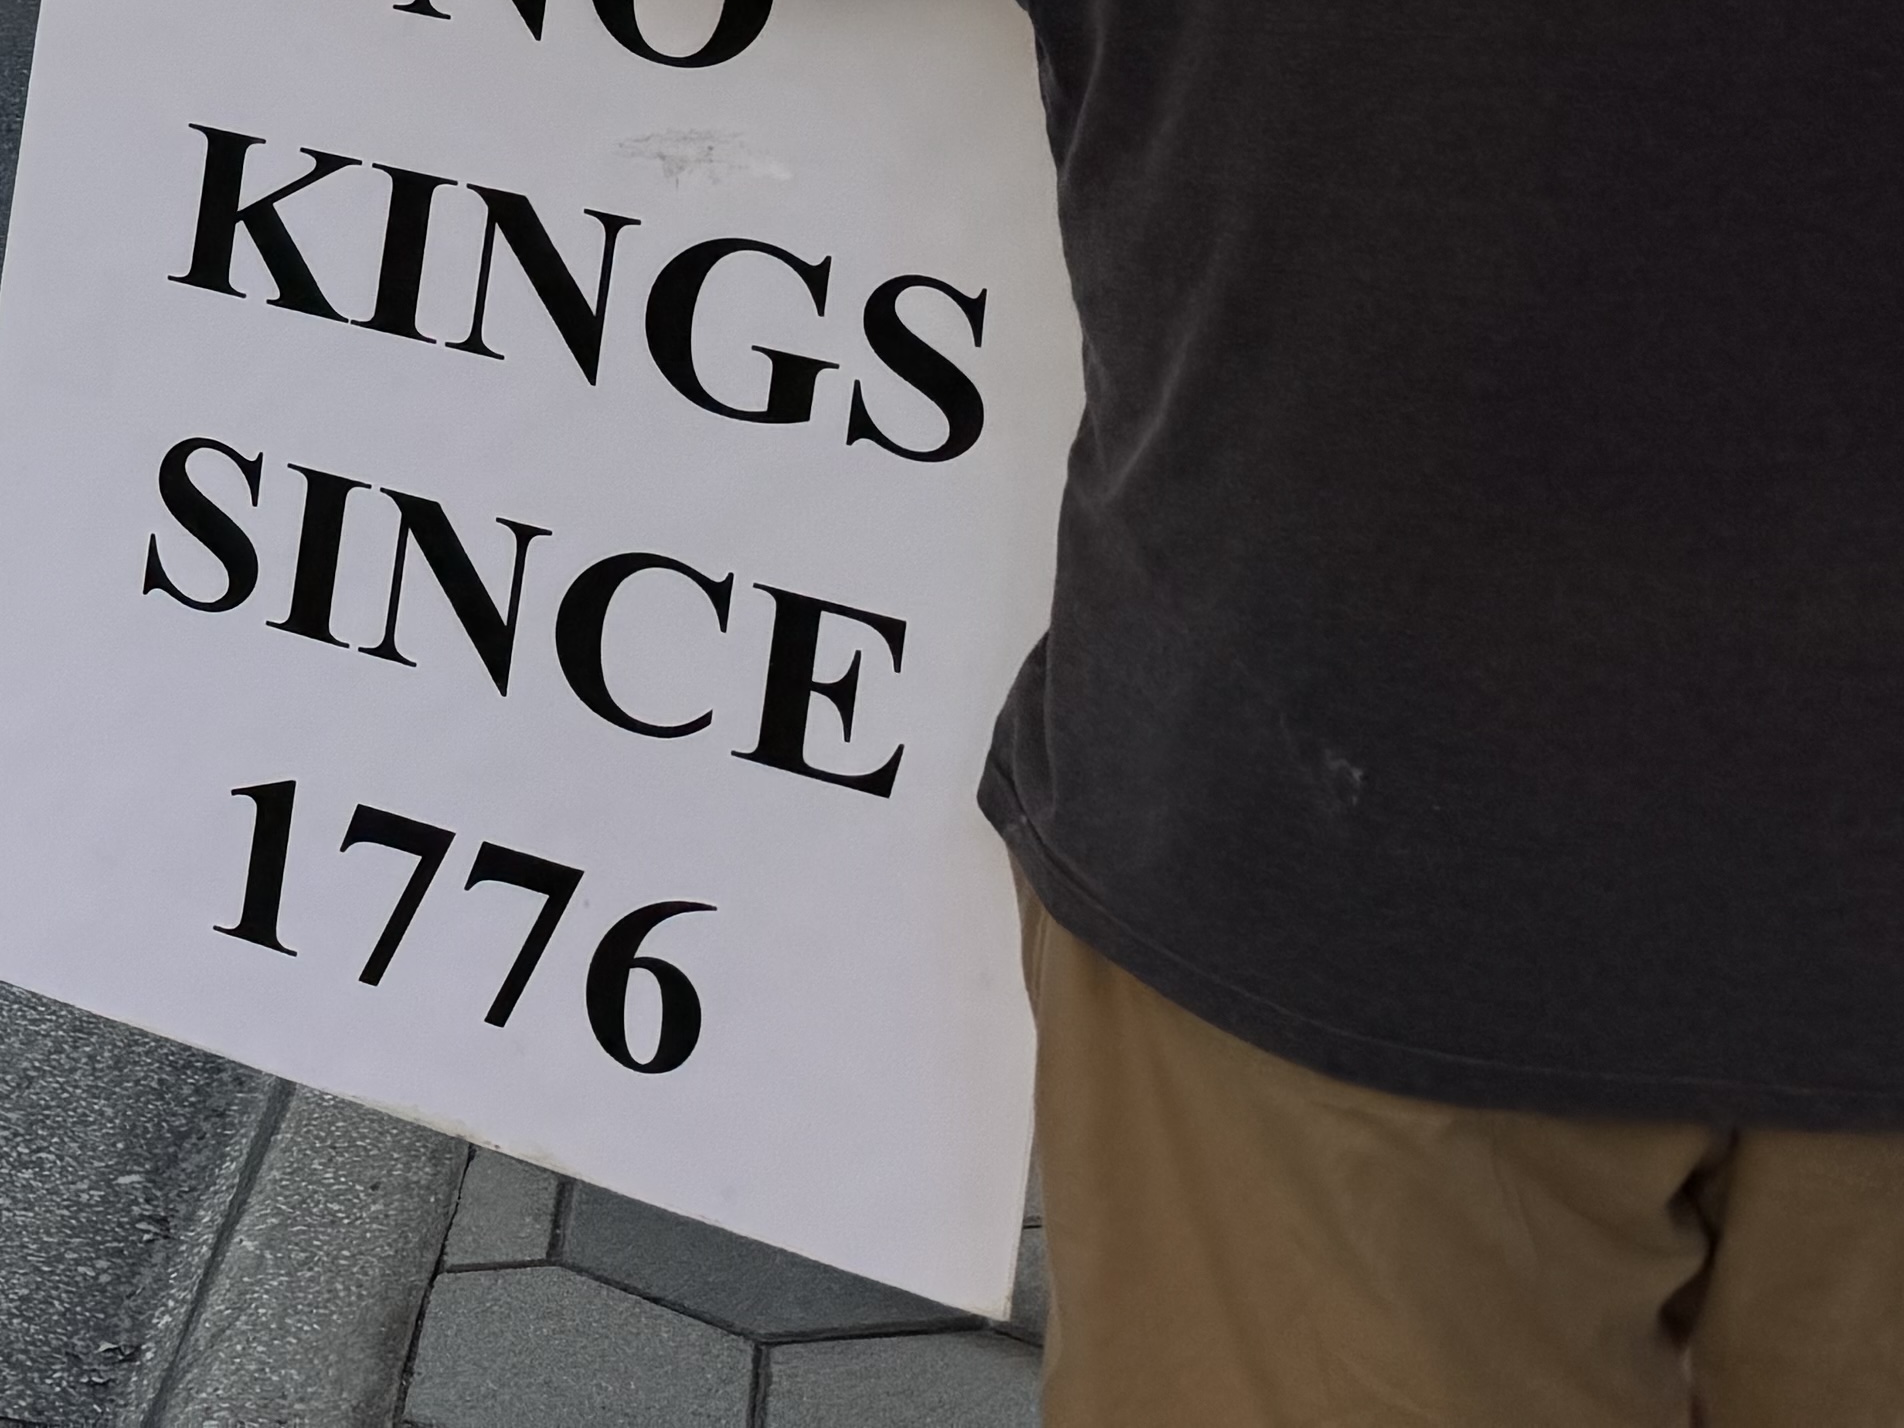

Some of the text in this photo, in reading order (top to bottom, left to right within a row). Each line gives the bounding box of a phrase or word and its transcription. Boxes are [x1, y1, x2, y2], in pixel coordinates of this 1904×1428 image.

[168, 123, 988, 463] KINGS
[142, 438, 907, 799] SINCE
[212, 780, 718, 1074] 1776
